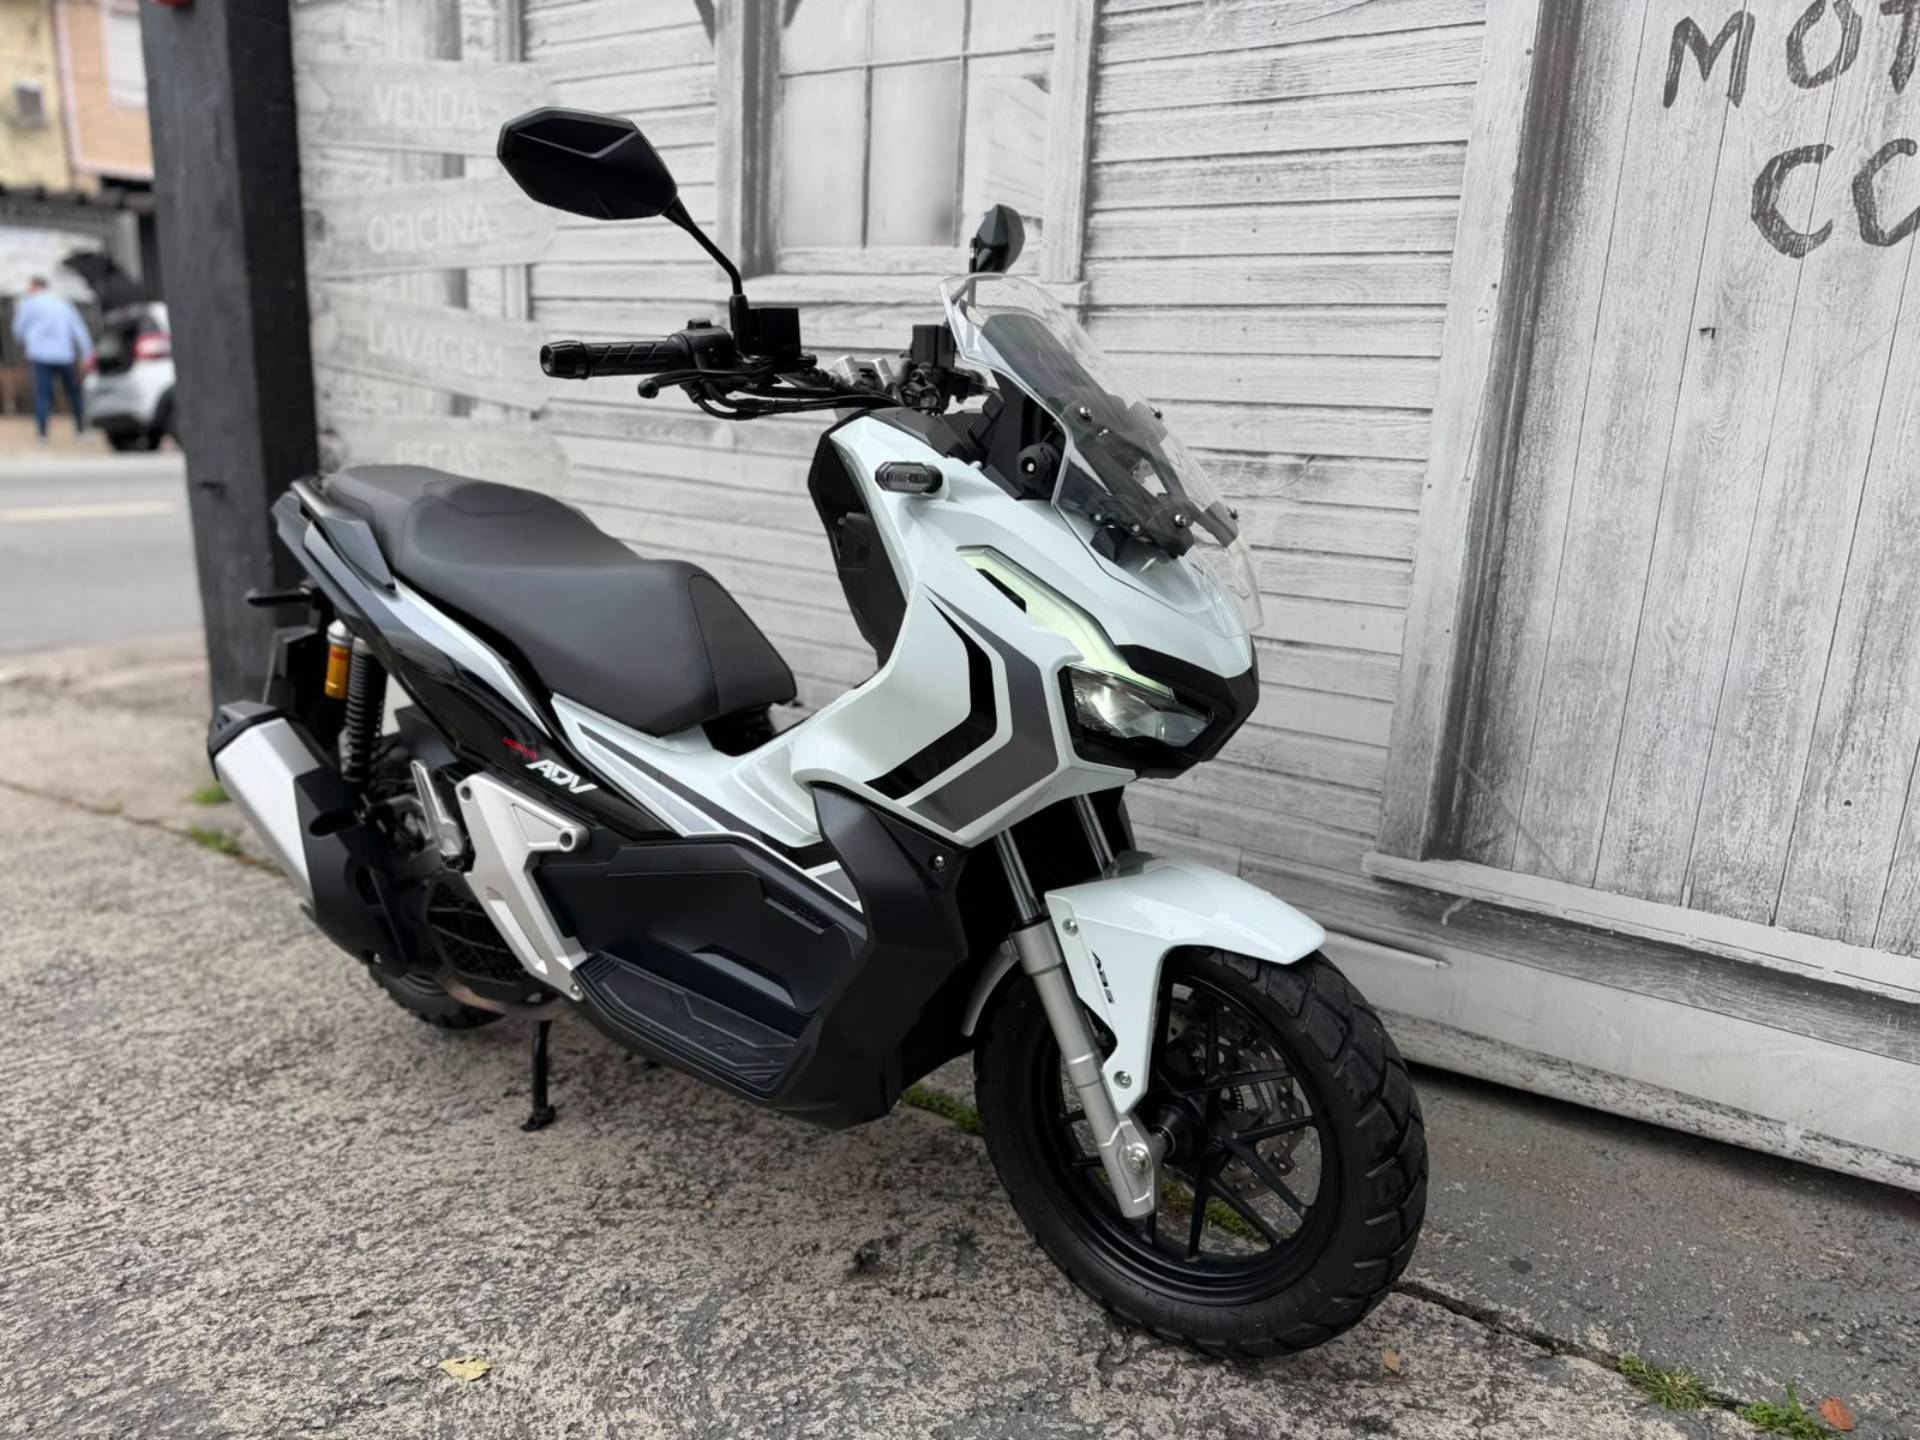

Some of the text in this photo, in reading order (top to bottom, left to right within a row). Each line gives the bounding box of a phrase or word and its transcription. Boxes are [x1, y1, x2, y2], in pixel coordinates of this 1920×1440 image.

[373, 83, 482, 129] VENDA
[367, 204, 490, 254] OFICINA
[367, 319, 504, 377] LAVAGEM
[525, 759, 598, 794] ADV
